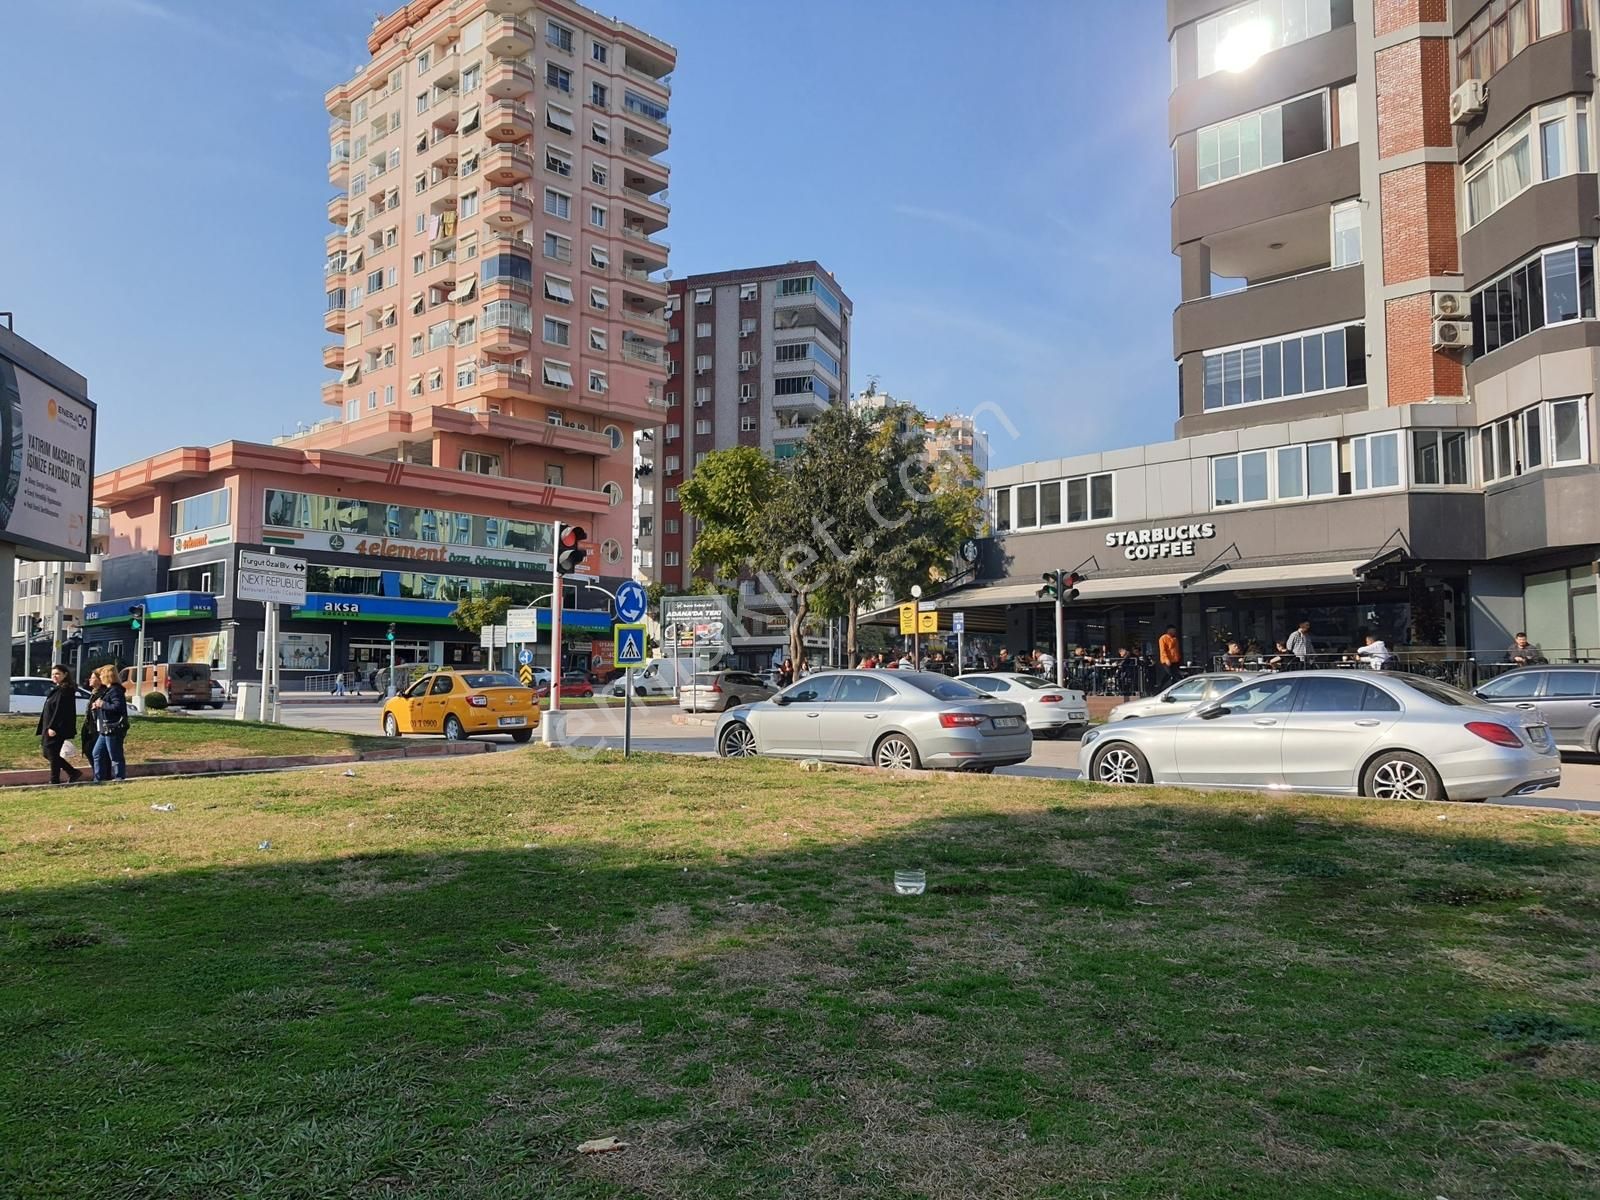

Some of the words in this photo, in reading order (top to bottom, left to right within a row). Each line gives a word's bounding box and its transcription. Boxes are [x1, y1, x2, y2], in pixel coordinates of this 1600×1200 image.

[1106, 523, 1214, 547] STARBUCKS
[355, 538, 448, 562] 4element
[1124, 541, 1196, 561] COFFEE
[243, 557, 265, 567] Turgut
[266, 558, 279, 567] Özal
[242, 574, 263, 585] NEXT
[266, 577, 304, 589] REPUBLIC
[324, 602, 359, 612] aksa
